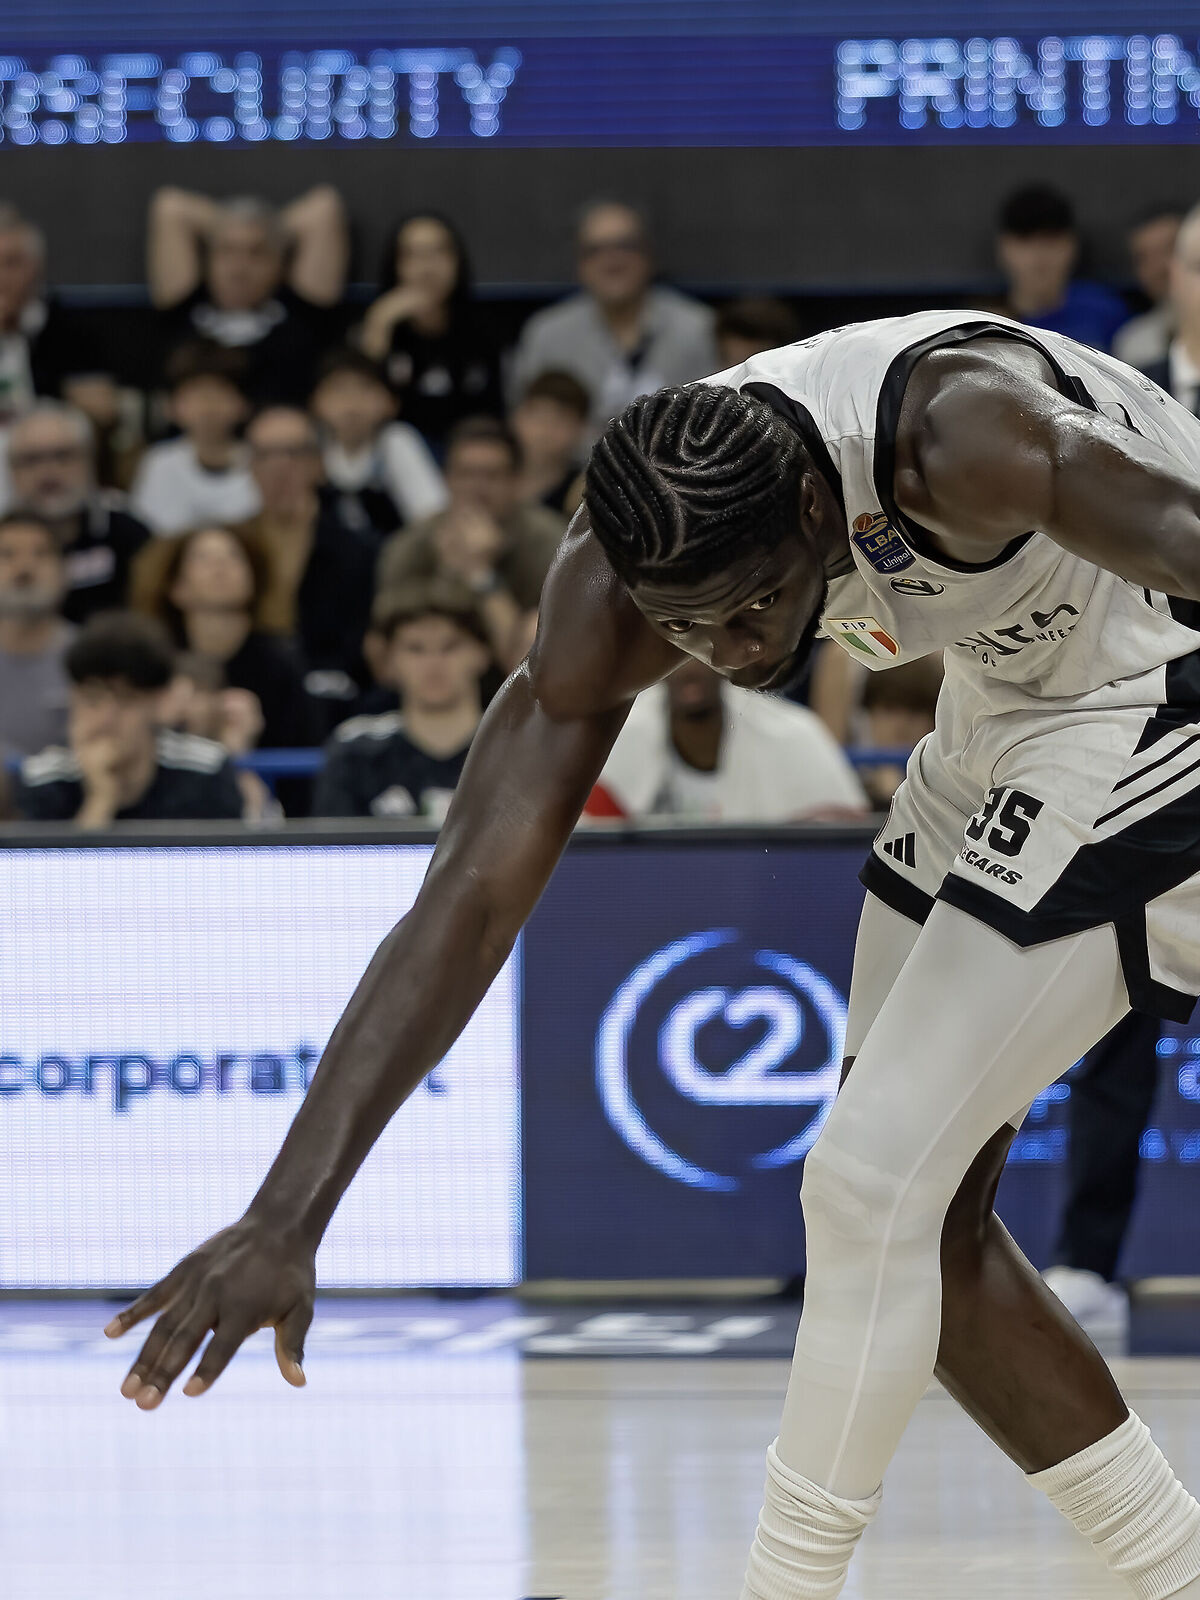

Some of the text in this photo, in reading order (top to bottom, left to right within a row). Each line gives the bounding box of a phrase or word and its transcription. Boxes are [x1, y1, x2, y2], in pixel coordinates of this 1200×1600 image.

[866, 527, 898, 555] LBA
[882, 550, 911, 570] Unipol
[841, 621, 867, 632] FIP
[966, 787, 1045, 857] 35
